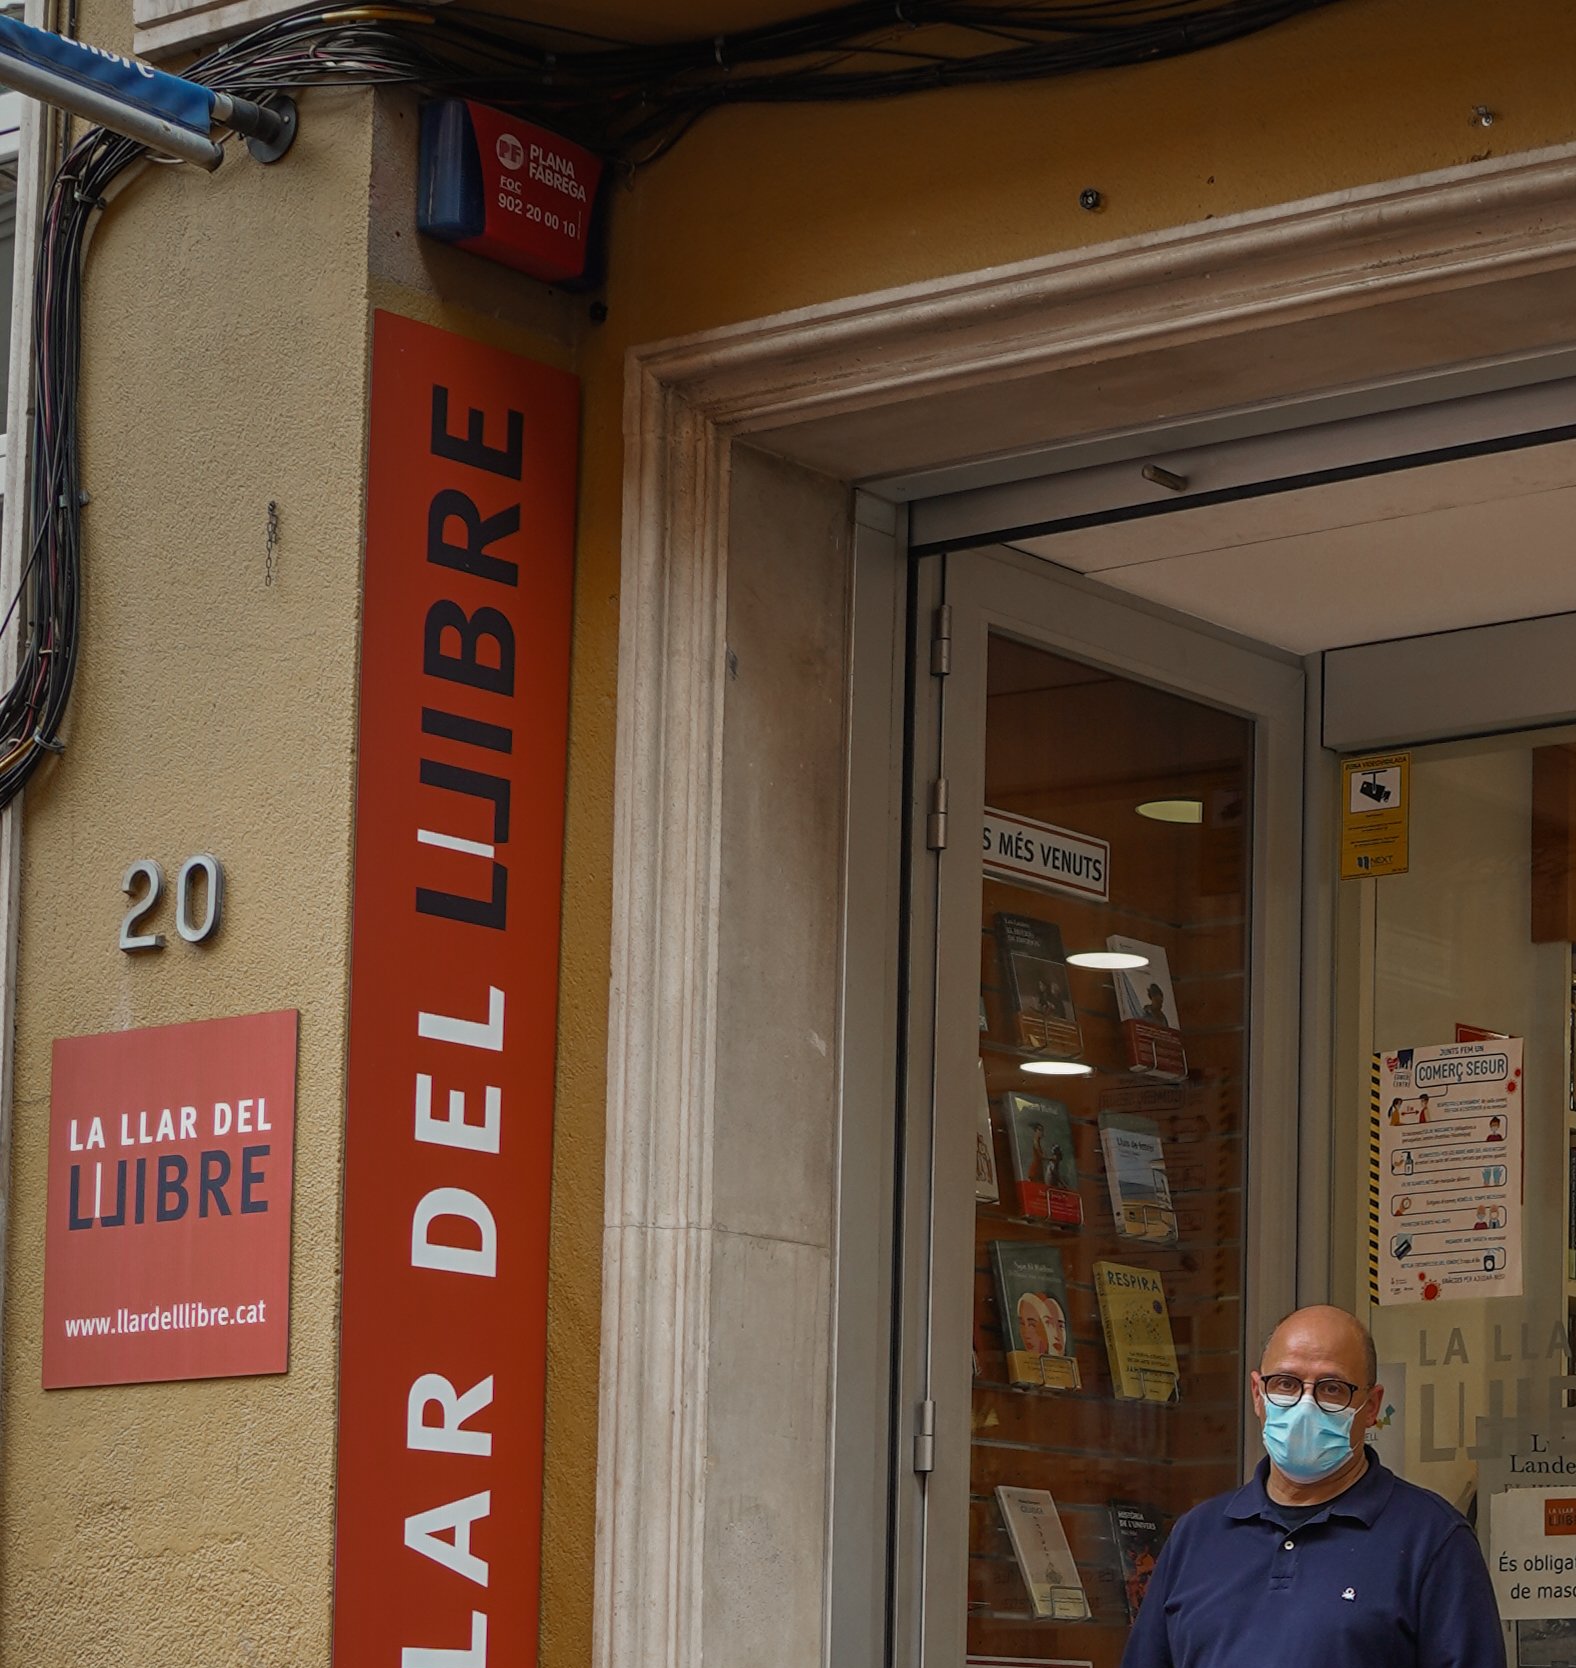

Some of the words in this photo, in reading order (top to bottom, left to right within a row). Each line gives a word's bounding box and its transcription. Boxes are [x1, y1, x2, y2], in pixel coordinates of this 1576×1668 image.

[530, 144, 575, 179] PLANA
[498, 193, 523, 215] 902
[525, 204, 542, 223] 20
[544, 212, 560, 231] 00
[562, 220, 576, 238] 10
[999, 831, 1034, 862] MÉS
[1040, 842, 1103, 882] VENUTS
[119, 852, 225, 953] 20
[1419, 1062, 1464, 1083] COMERÇ
[1466, 1058, 1506, 1077] SEGUR
[70, 1115, 106, 1152] LA
[120, 1105, 198, 1147] LLAR
[213, 1097, 272, 1136] DEL
[410, 985, 506, 1278] DEL
[1107, 1270, 1162, 1294] RESPIRA
[65, 1300, 267, 1339] www.llardelllibre.cat
[1419, 1327, 1469, 1367] LA
[1499, 1551, 1518, 1572] És
[1510, 1583, 1531, 1600] de
